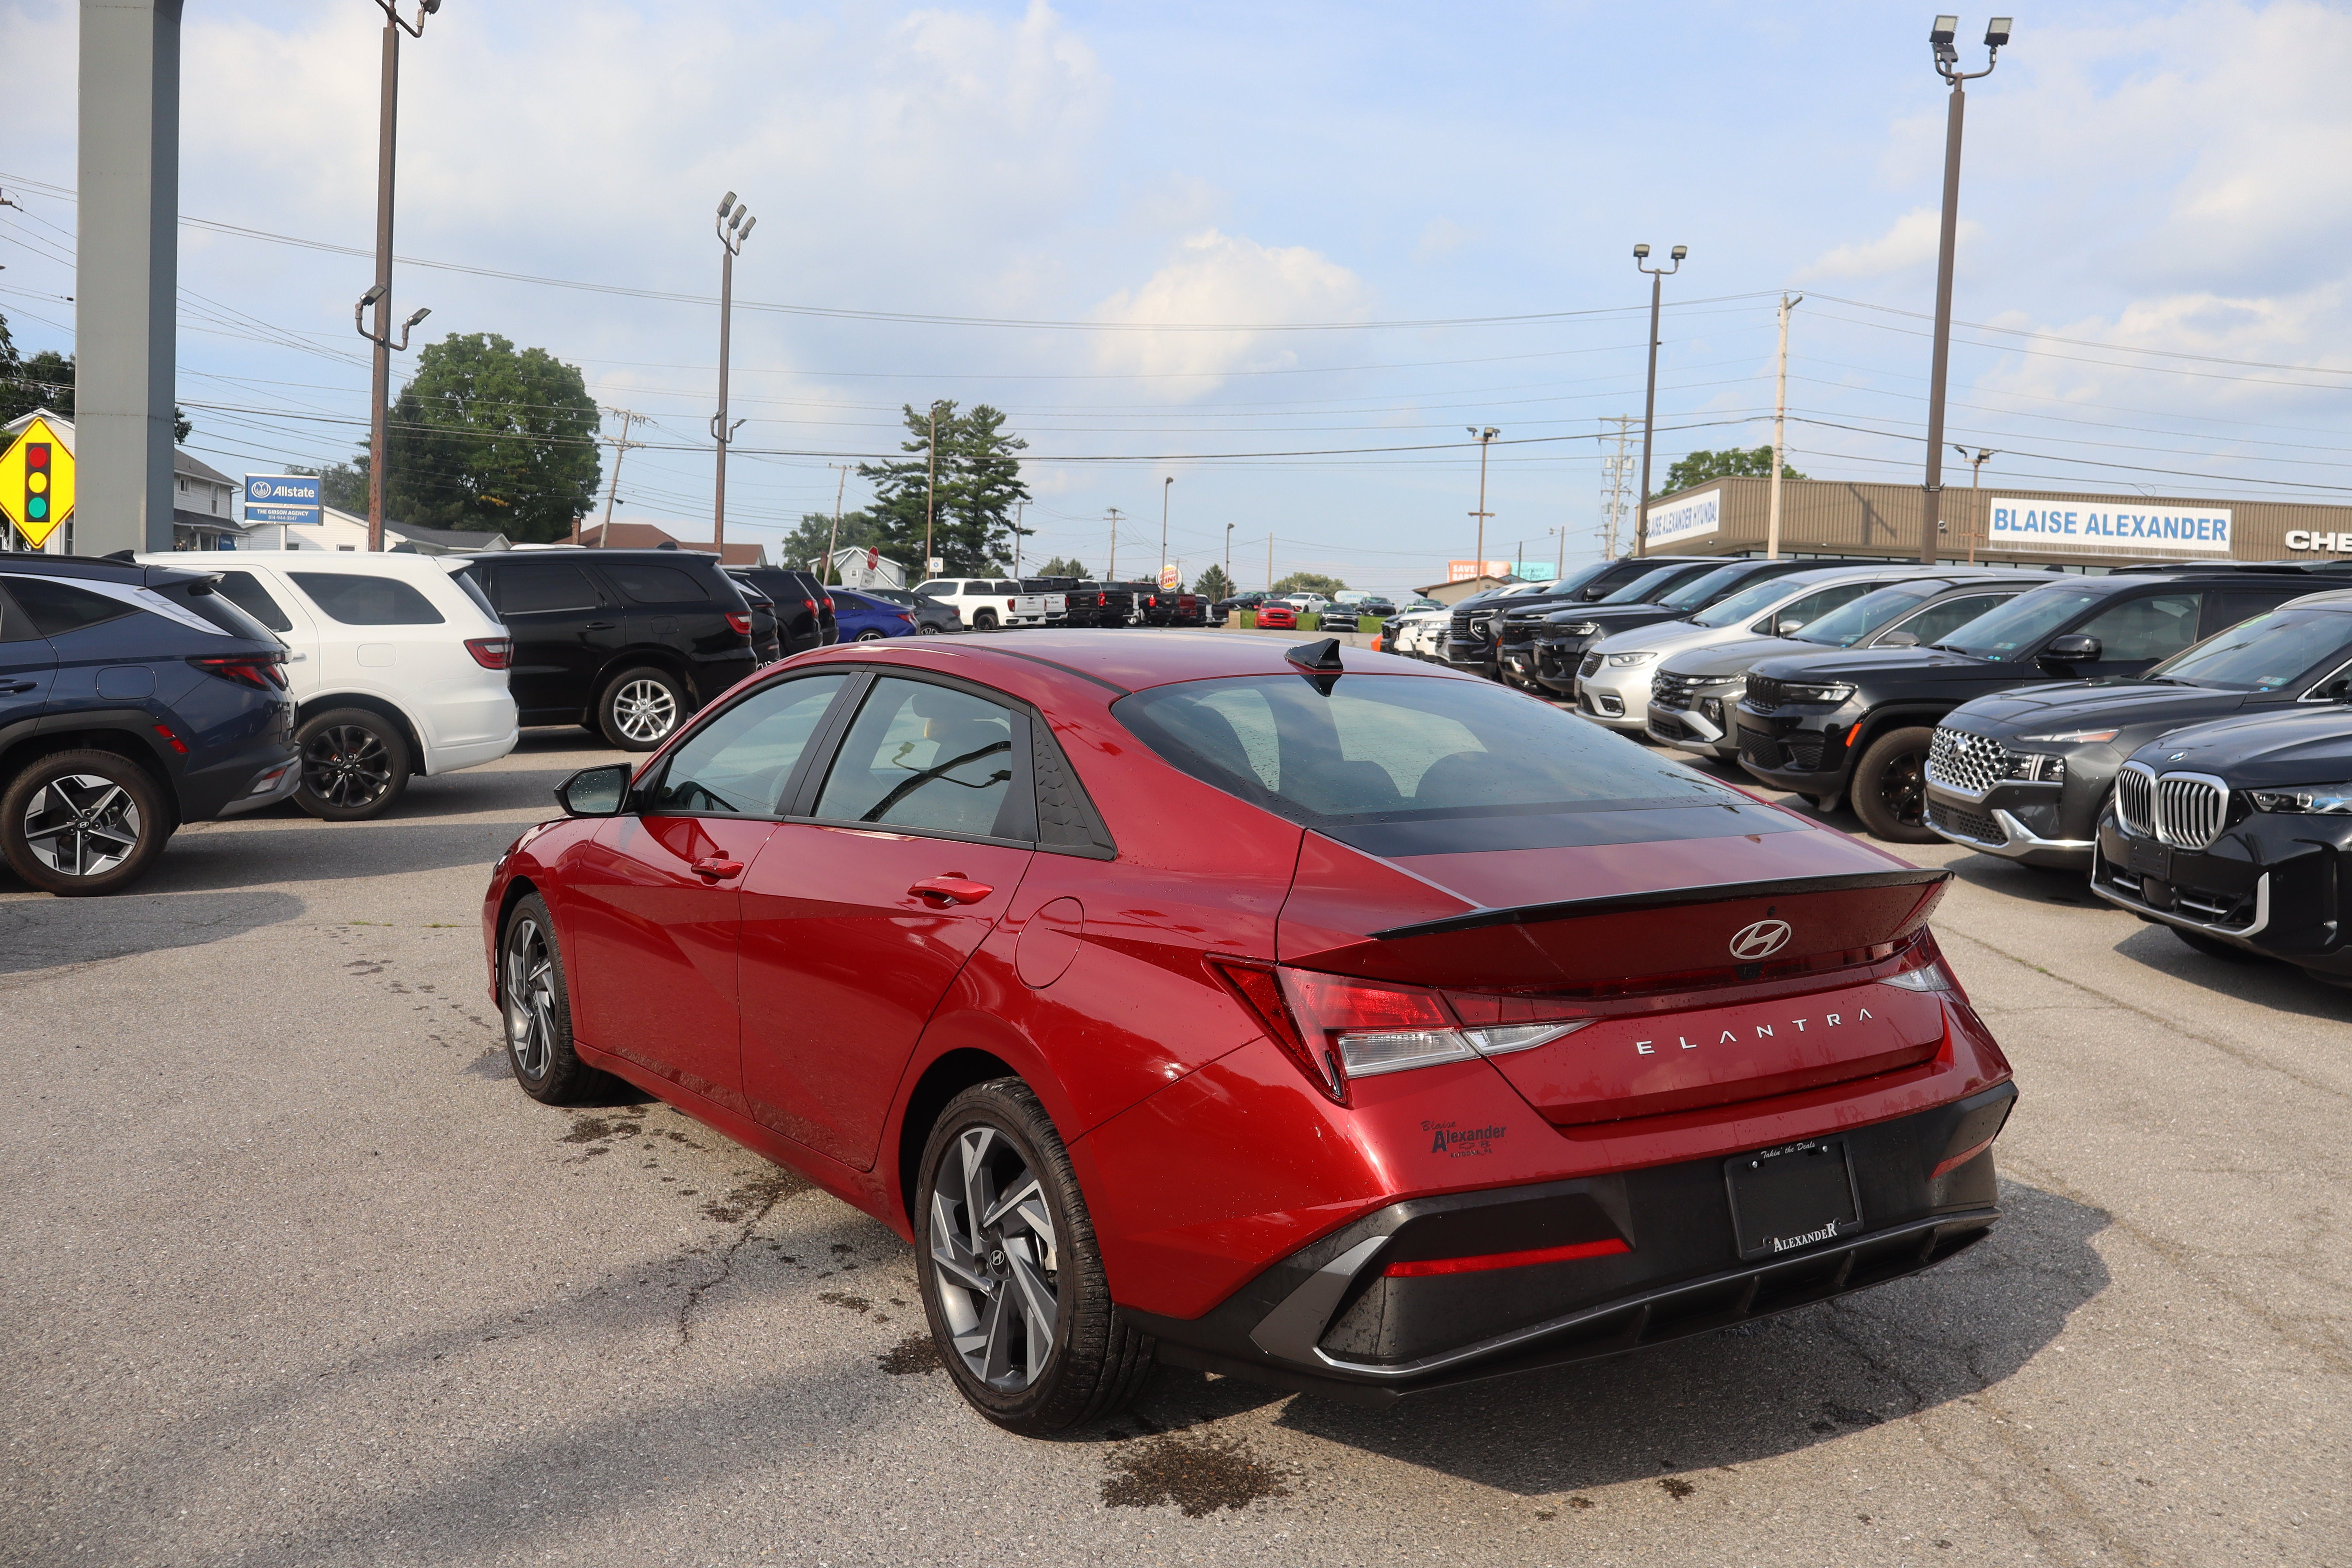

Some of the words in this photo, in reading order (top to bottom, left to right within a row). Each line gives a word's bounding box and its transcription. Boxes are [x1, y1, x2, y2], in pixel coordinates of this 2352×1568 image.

[272, 486, 314, 498] Allstate
[1662, 507, 1692, 535] ALEXANDER
[1693, 500, 1717, 527] HYUNDAI
[1993, 508, 2078, 534] BLAISE
[2085, 513, 2227, 541] ALEXANDER
[2285, 530, 2352, 552] CHE
[868, 552, 878, 564] STOP
[1160, 575, 1178, 586] KING
[1636, 1008, 1873, 1055] ELANTRA
[1421, 1120, 1457, 1131] Blaise
[1432, 1125, 1507, 1153] Alexander
[1760, 1147, 1782, 1159] Takin'
[1784, 1145, 1794, 1154] the
[1796, 1141, 1815, 1151] Deals
[1773, 1222, 1838, 1253] ALEXANDER
